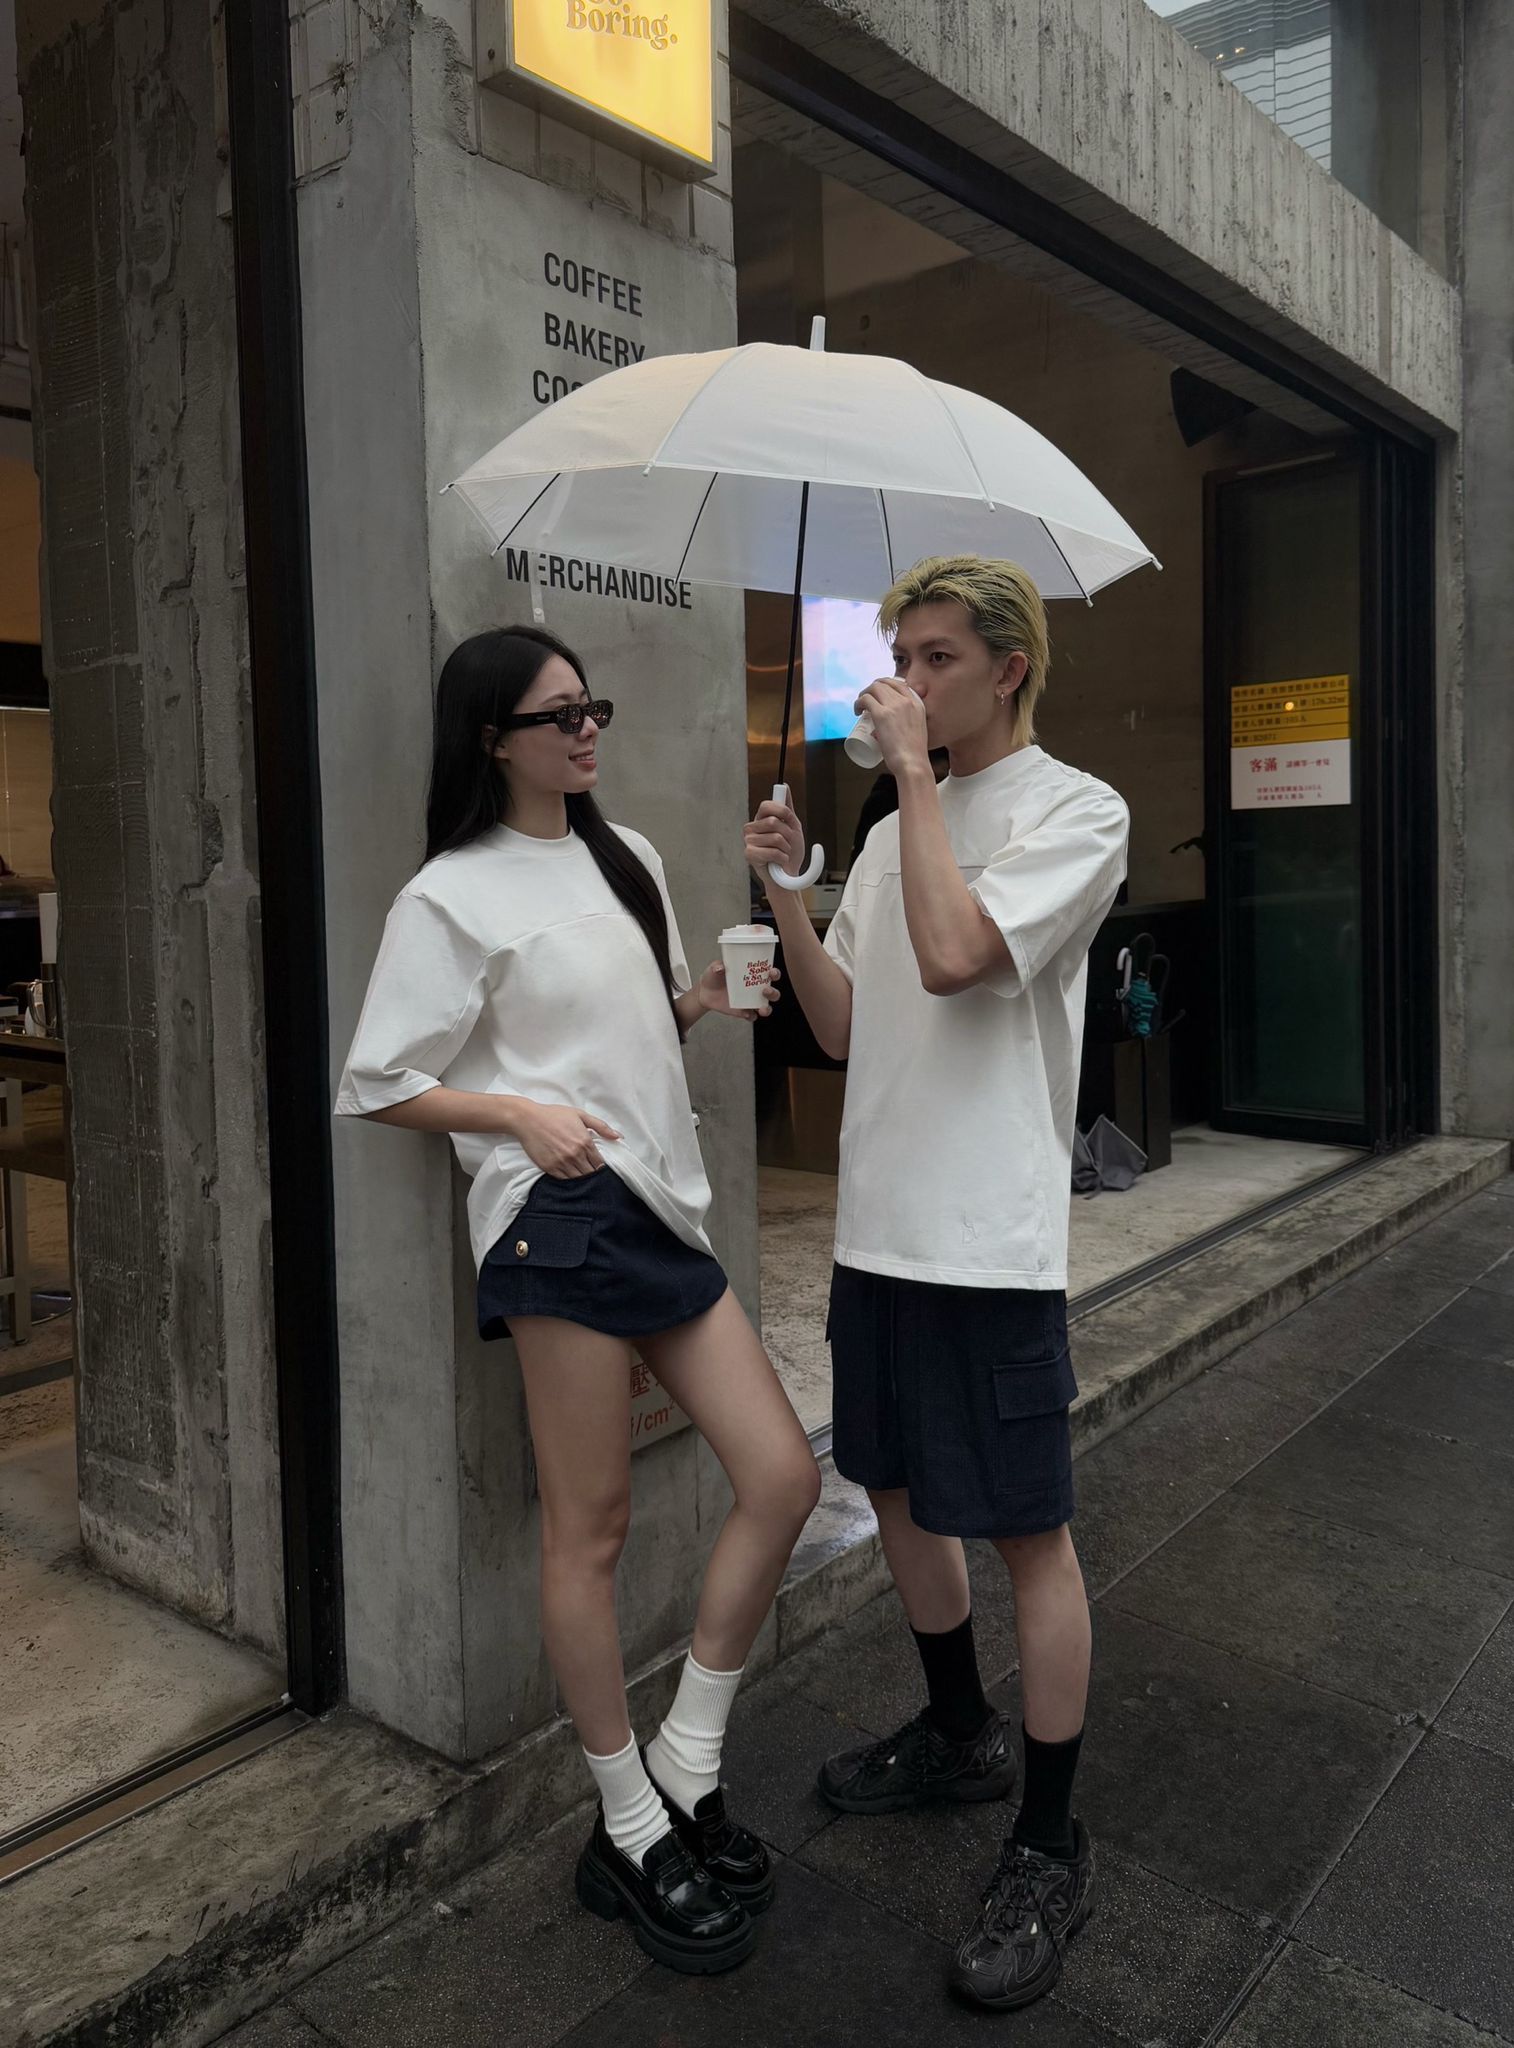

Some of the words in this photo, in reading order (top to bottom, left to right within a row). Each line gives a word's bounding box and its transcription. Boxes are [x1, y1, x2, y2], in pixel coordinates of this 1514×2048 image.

[566, 0, 678, 50] Boring.
[544, 252, 642, 318] COFFEE
[544, 312, 646, 368] BAKERY
[506, 548, 692, 610] MERCHANDISE
